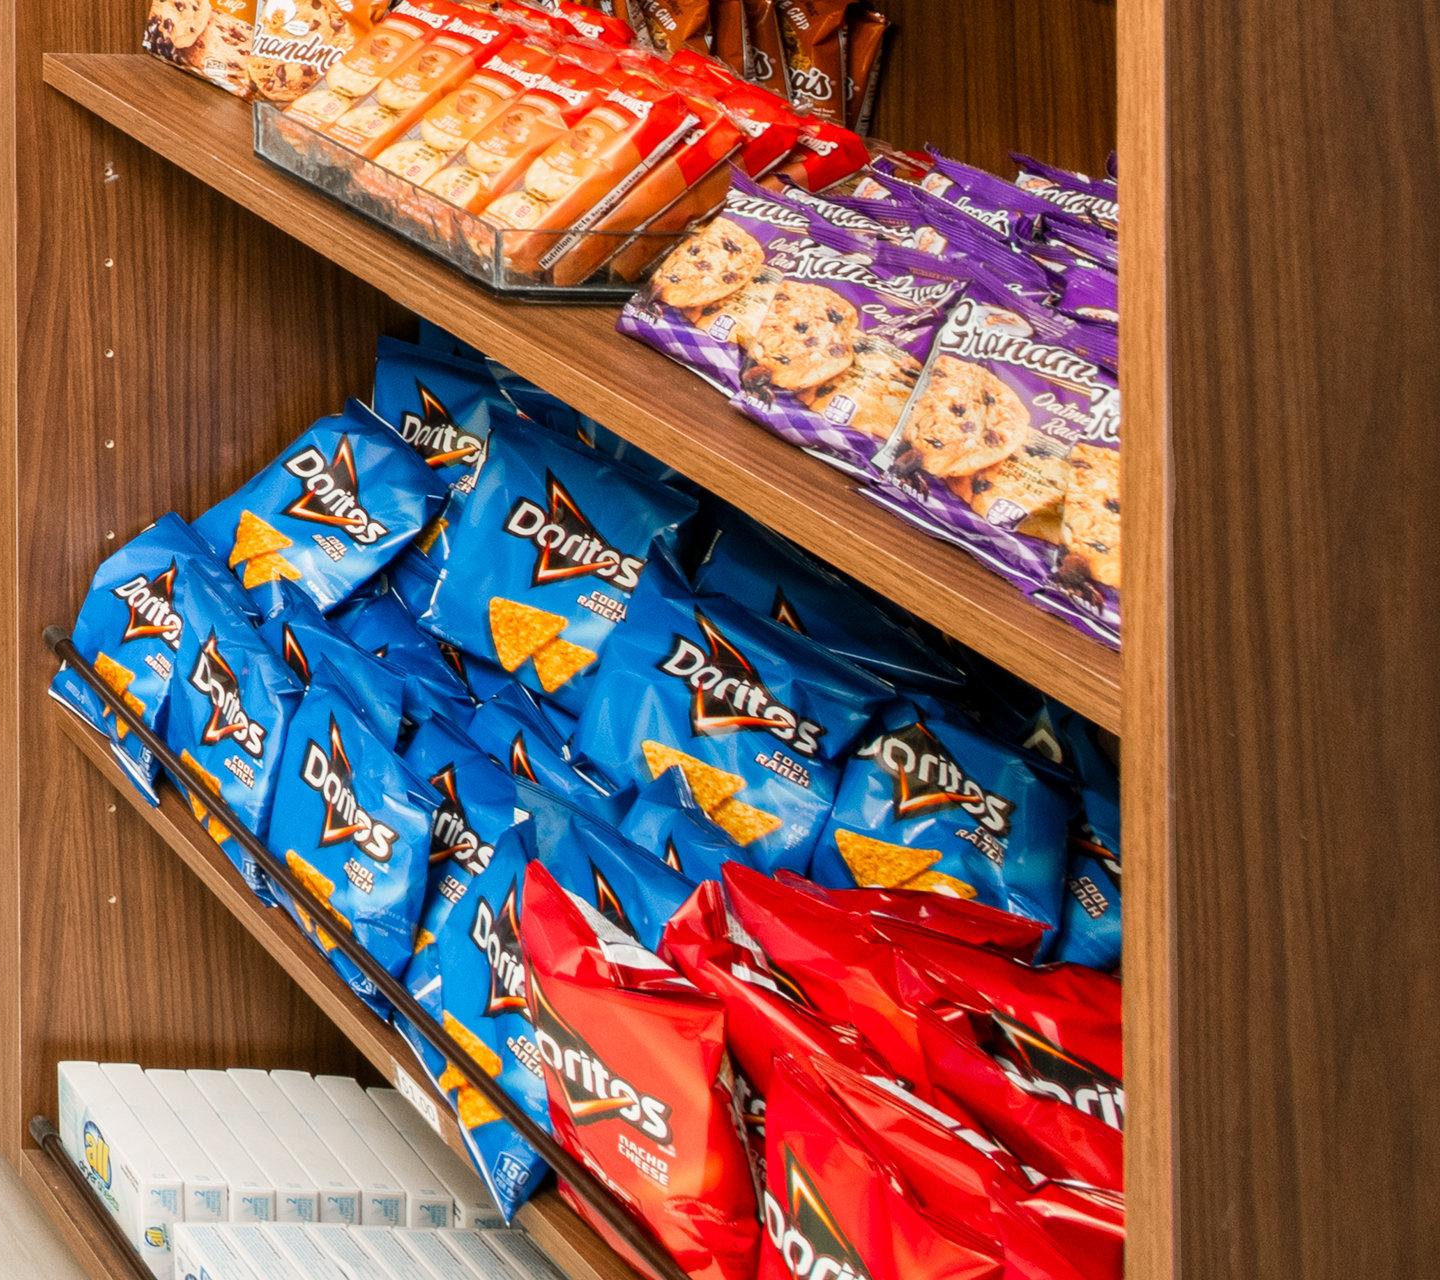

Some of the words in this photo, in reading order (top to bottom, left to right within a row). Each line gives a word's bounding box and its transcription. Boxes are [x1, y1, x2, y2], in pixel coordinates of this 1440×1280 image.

[655, 7, 677, 32] CHIP
[787, 4, 810, 32] CHIP
[541, 234, 572, 269] Nutrition
[572, 216, 592, 238] Facts
[288, 448, 388, 543] Doritos
[994, 501, 1023, 520] 310
[313, 535, 344, 562] RANCH
[325, 534, 350, 553] COOL
[505, 500, 644, 588] Doritos
[114, 575, 182, 646] Dorito
[577, 595, 623, 623] RANCH
[590, 589, 625, 614] COOL
[193, 655, 264, 758] Doritos
[664, 638, 822, 757] Doritos
[223, 760, 254, 789] RANCH
[231, 754, 256, 779] COOL
[755, 752, 810, 789] RANCH
[772, 749, 811, 778] COOL
[303, 744, 395, 858] Doritos
[1078, 875, 1109, 905] COOL
[84, 1132, 109, 1185] all
[617, 1144, 670, 1186] CHEESE
[618, 1134, 668, 1172] NACHO
[503, 1157, 529, 1185] 150
